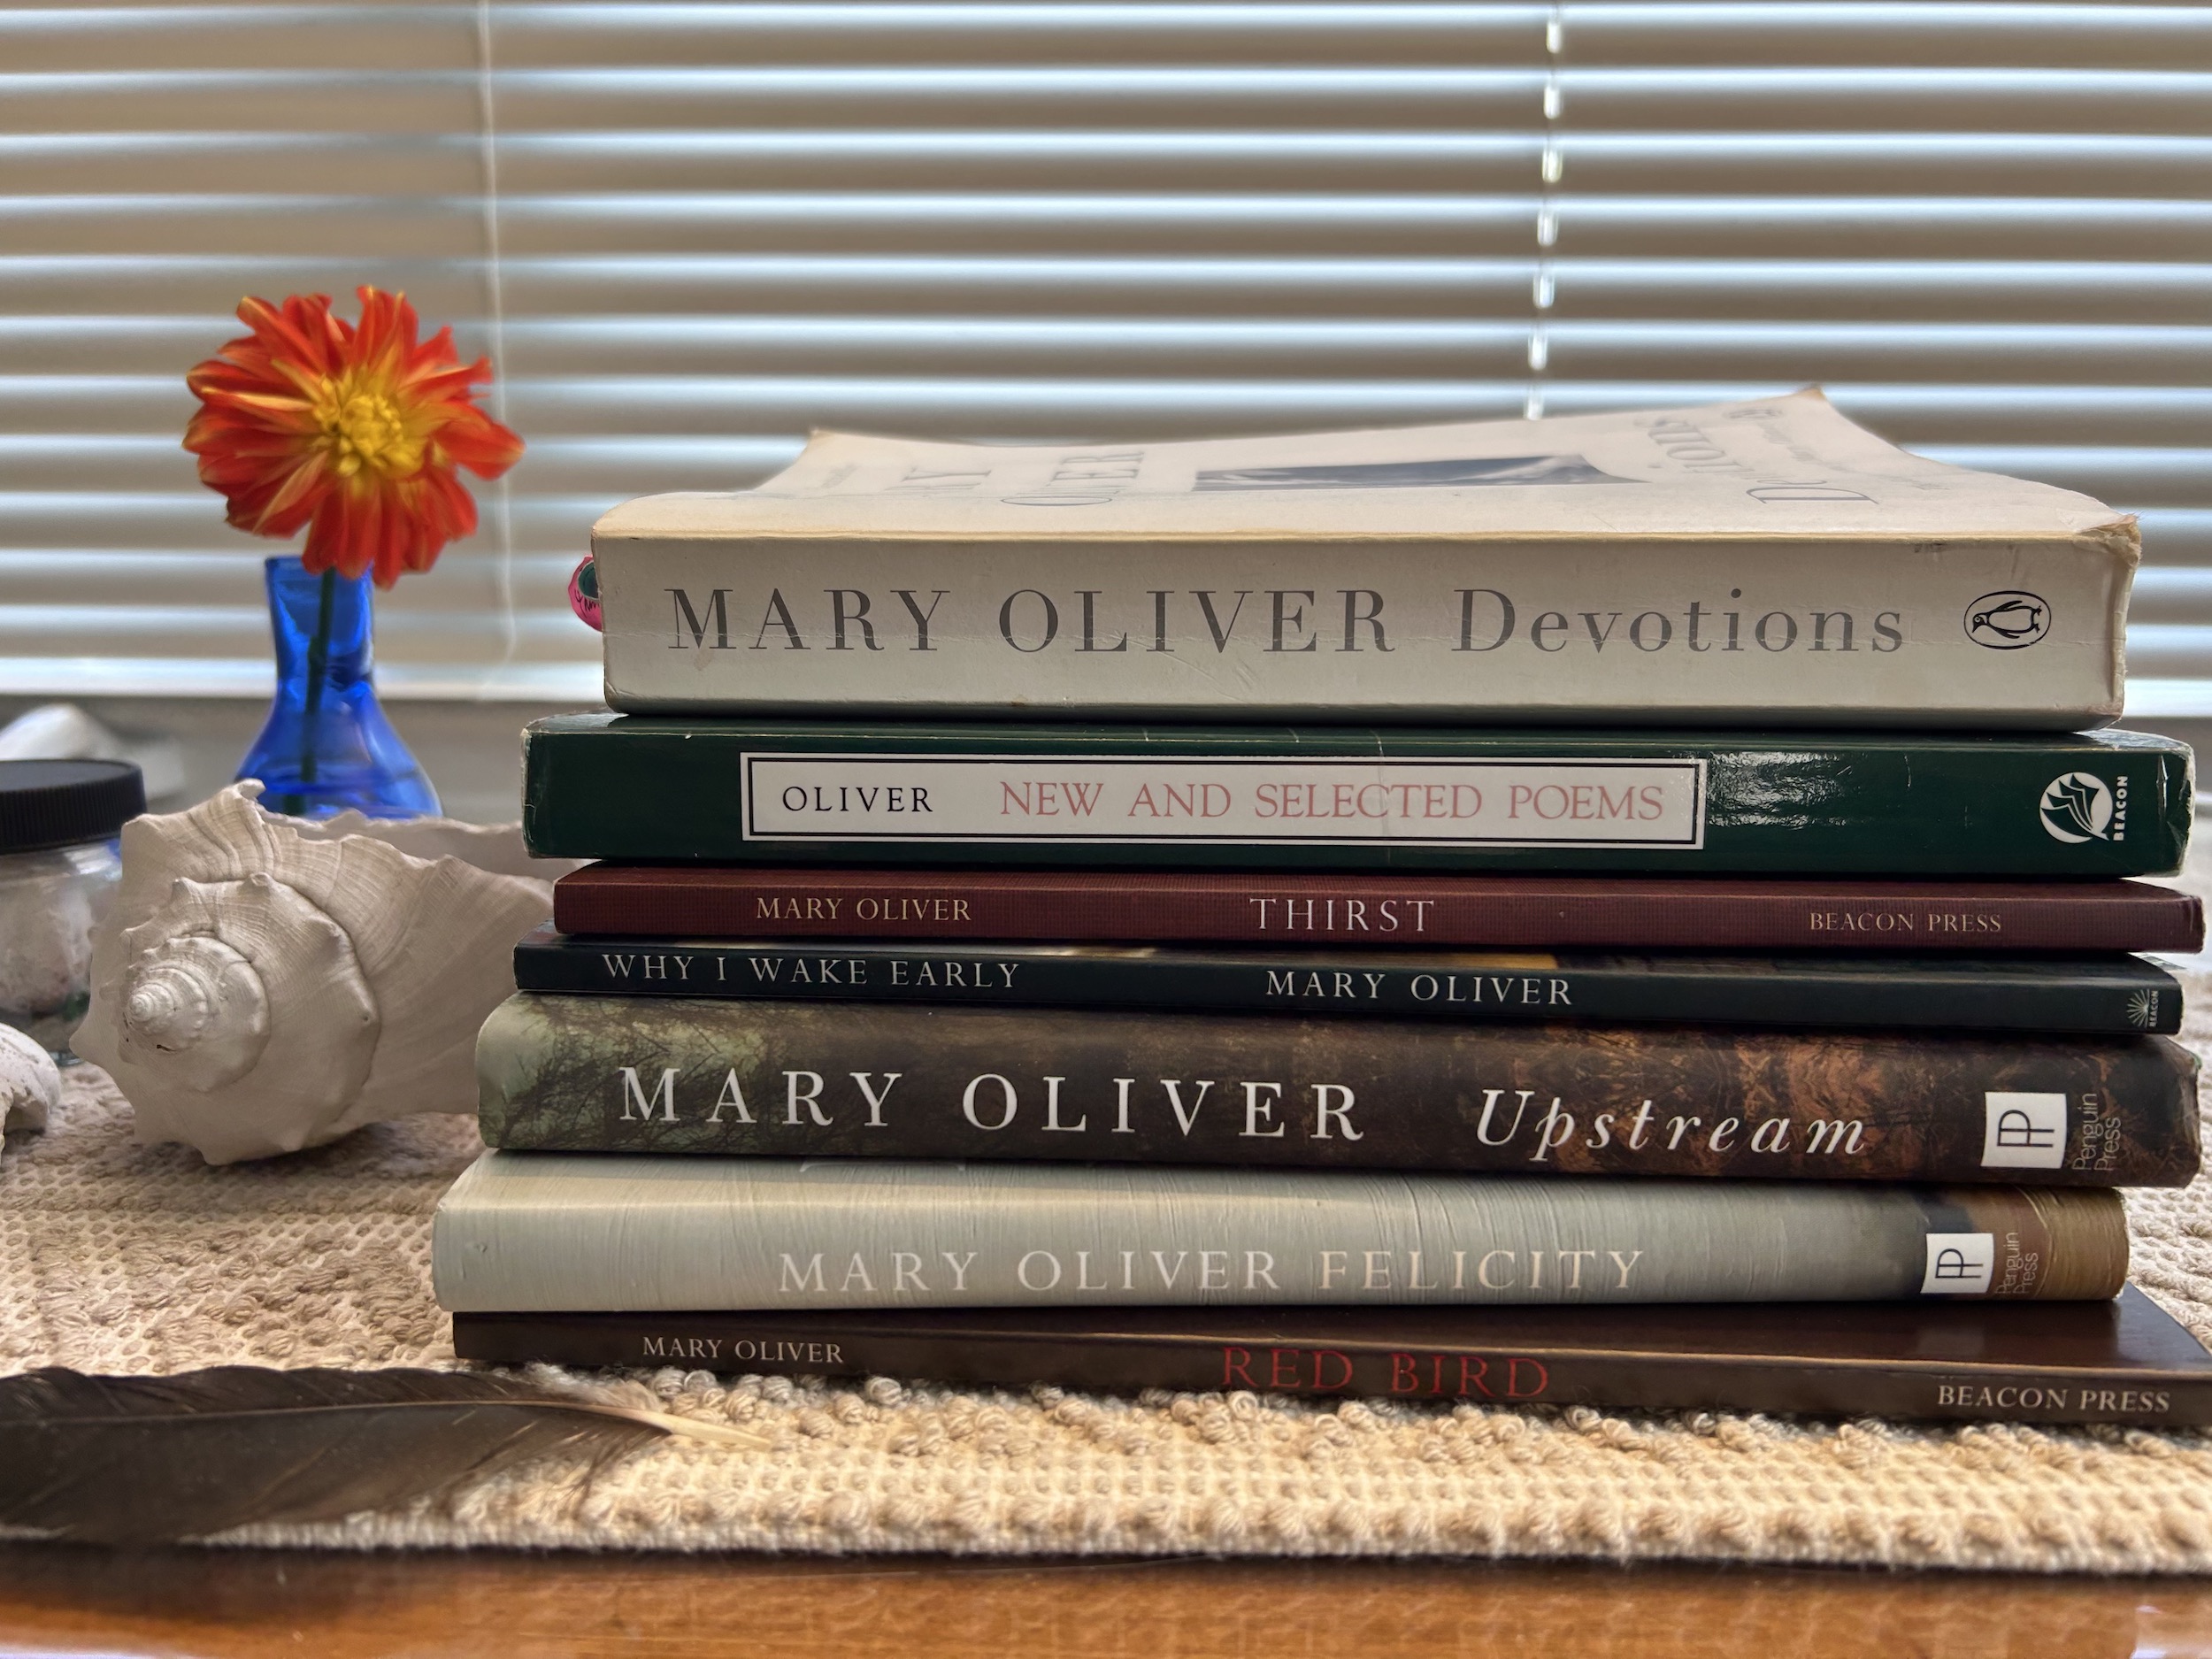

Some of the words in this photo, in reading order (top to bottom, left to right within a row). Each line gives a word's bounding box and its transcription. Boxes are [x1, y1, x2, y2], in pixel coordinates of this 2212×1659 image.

[664, 588, 951, 651] MARY
[999, 588, 1395, 654] OLIVER
[1450, 588, 1903, 654] Devotions
[782, 786, 933, 812] OLIVER
[1001, 781, 1102, 817] NEW
[1128, 782, 1232, 818] AND
[1255, 783, 1483, 820] SELECTED
[1509, 785, 1663, 821] POEMS
[2112, 775, 2129, 841] BEACON
[757, 897, 843, 919] MARY
[856, 898, 972, 921] OLIVER
[1249, 897, 1434, 932] THIRST
[1810, 912, 1913, 931] BEACON
[1928, 913, 2001, 932] PRESS
[601, 954, 695, 979] WHY
[717, 956, 726, 981] I
[748, 957, 867, 985] WAKE
[890, 960, 1019, 988] EARLY
[1266, 970, 1386, 999] MARY
[1410, 972, 1574, 1005] OLIVER
[2148, 990, 2159, 1027] BEACON
[618, 1066, 902, 1126] MARY
[963, 1073, 1363, 1141] OLIVER
[1477, 1088, 1864, 1162] Upstream
[2071, 1093, 2104, 1171] Penguin
[2093, 1117, 2122, 1171] Press
[780, 1251, 978, 1292] MARY
[1018, 1249, 1279, 1290] OLIVER
[1319, 1249, 1643, 1289] FELICITY
[1993, 1232, 2024, 1294] Penguin
[2012, 1252, 2039, 1294] Press
[643, 1336, 723, 1358] MARY
[734, 1340, 843, 1363] OLIVER
[1223, 1346, 1353, 1389] RED
[1389, 1352, 1549, 1397] BIRD
[1938, 1385, 2067, 1409] BEACON
[2079, 1389, 2170, 1411] PRESS
